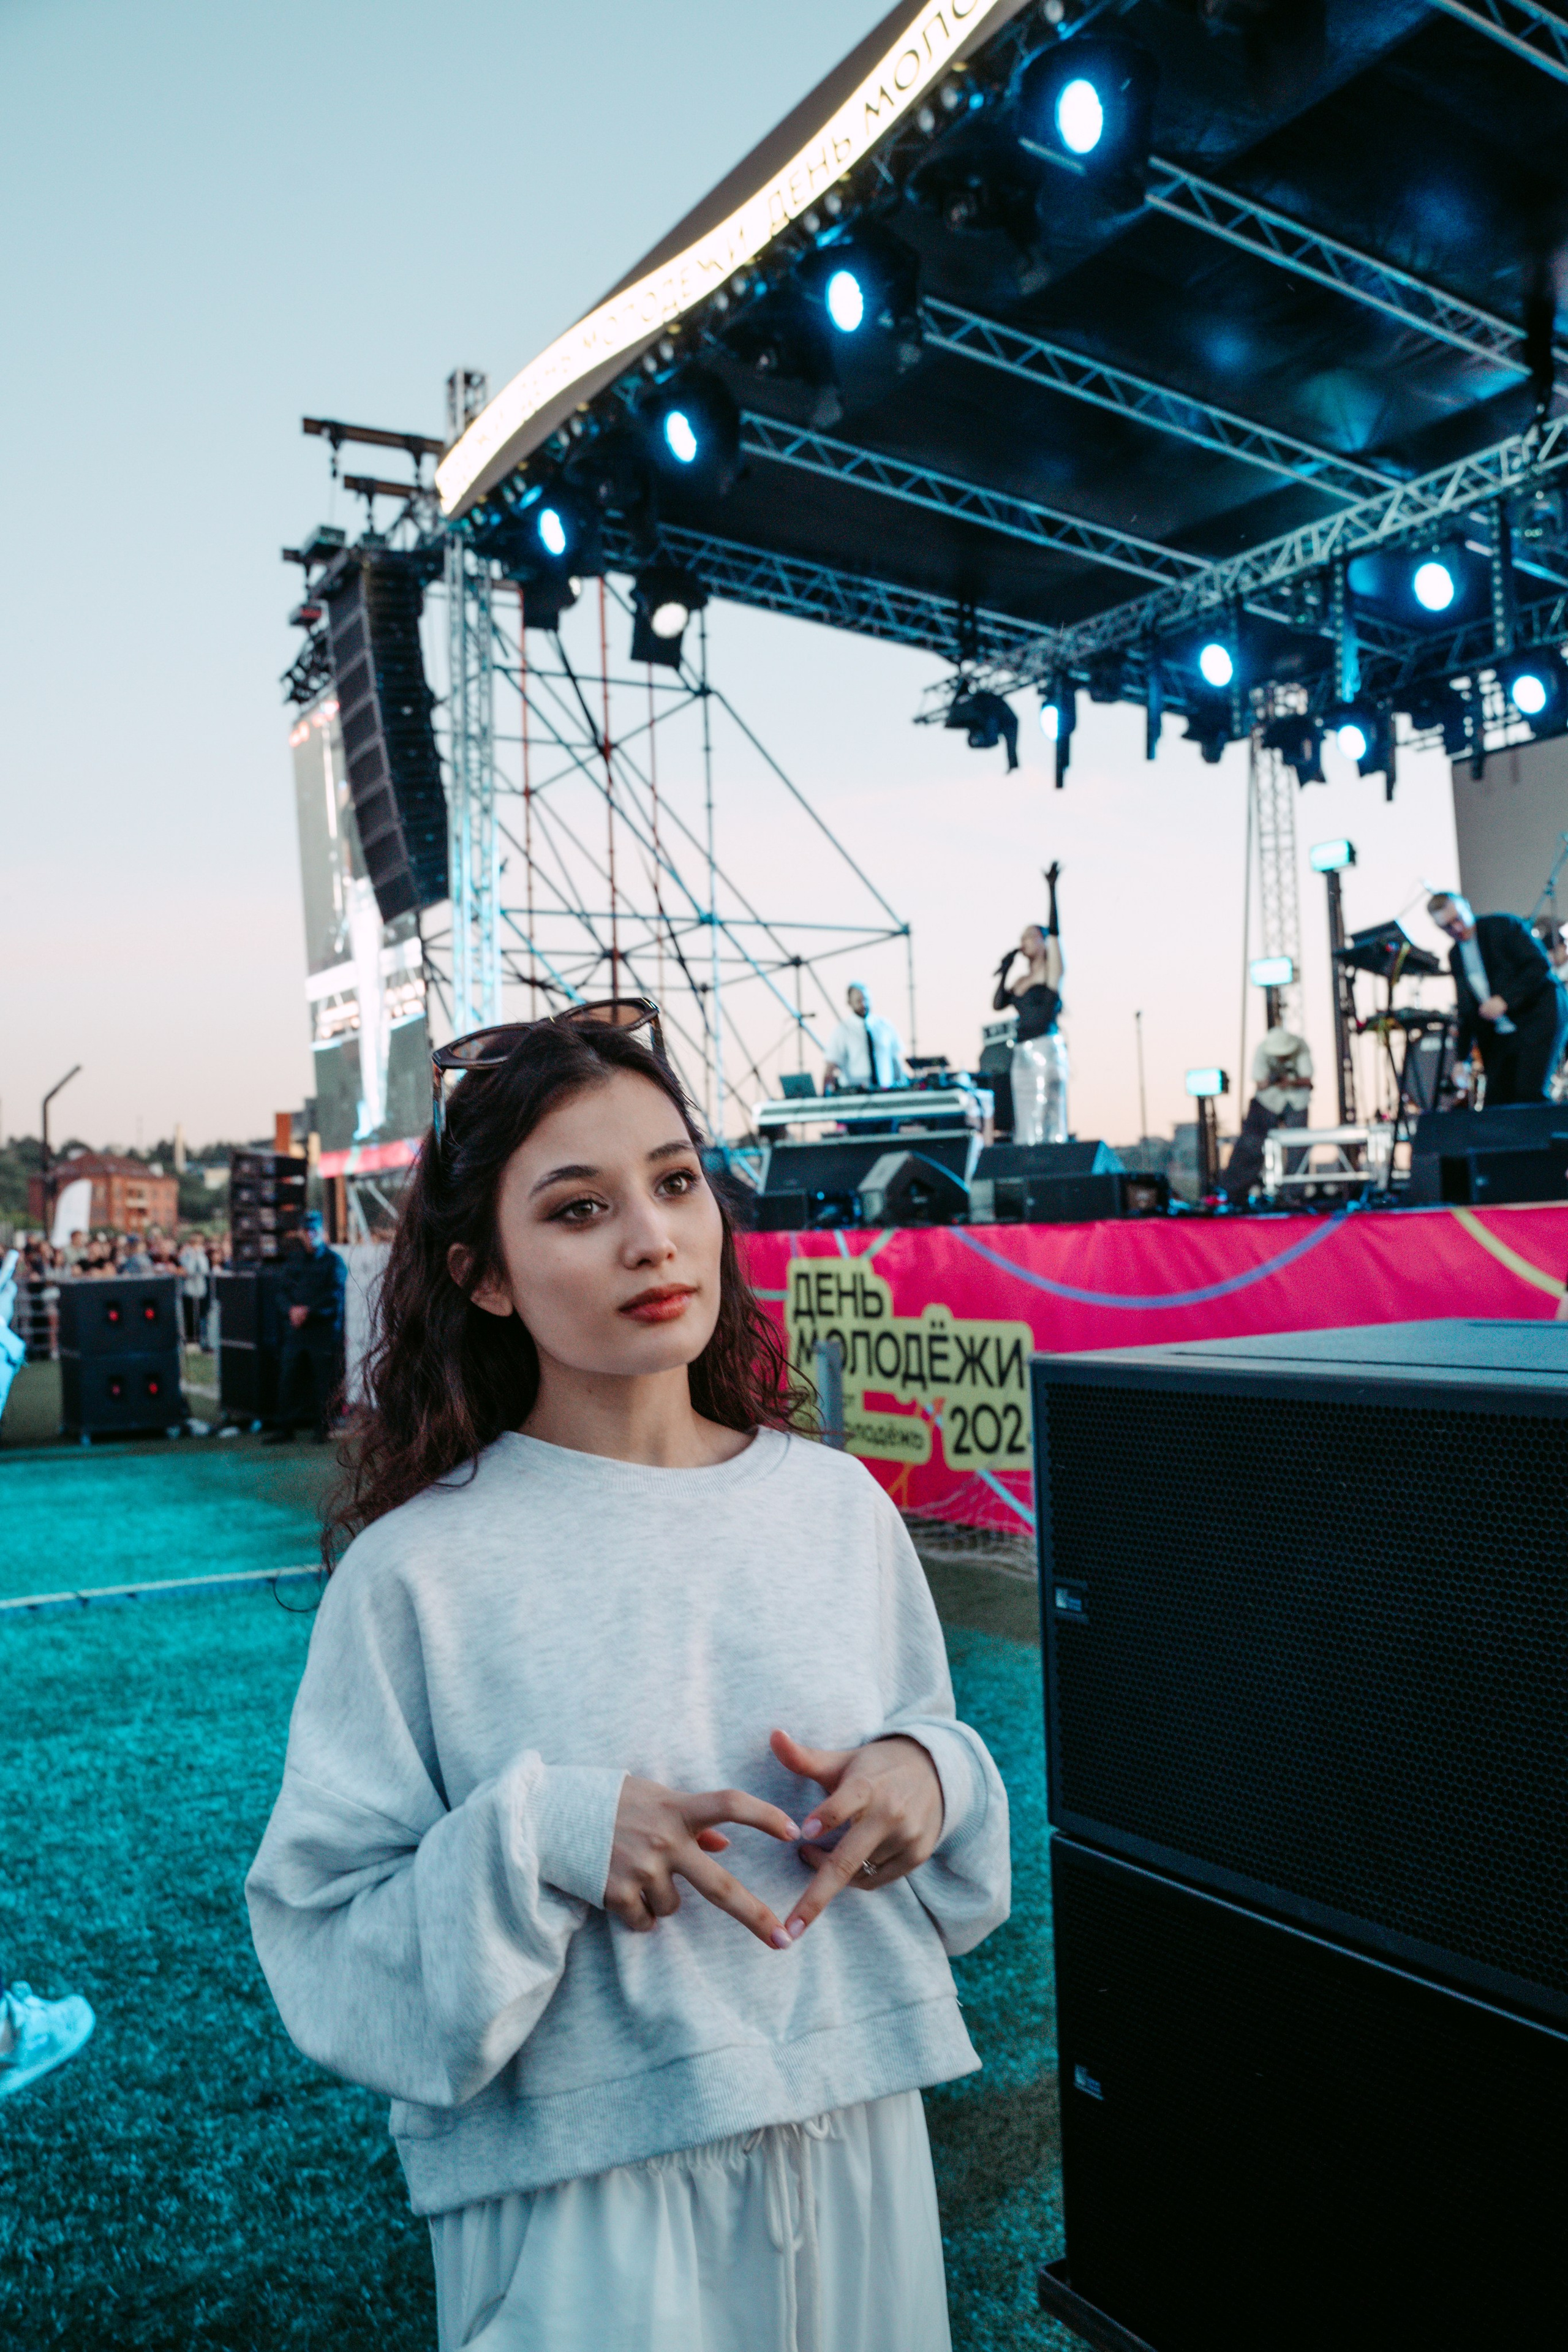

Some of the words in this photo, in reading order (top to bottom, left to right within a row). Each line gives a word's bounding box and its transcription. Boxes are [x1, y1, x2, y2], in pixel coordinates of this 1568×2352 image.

[767, 136, 851, 236] ДЕНЬ
[793, 1272, 884, 1324] ДЕНЬ
[949, 1404, 1031, 1455] 202
